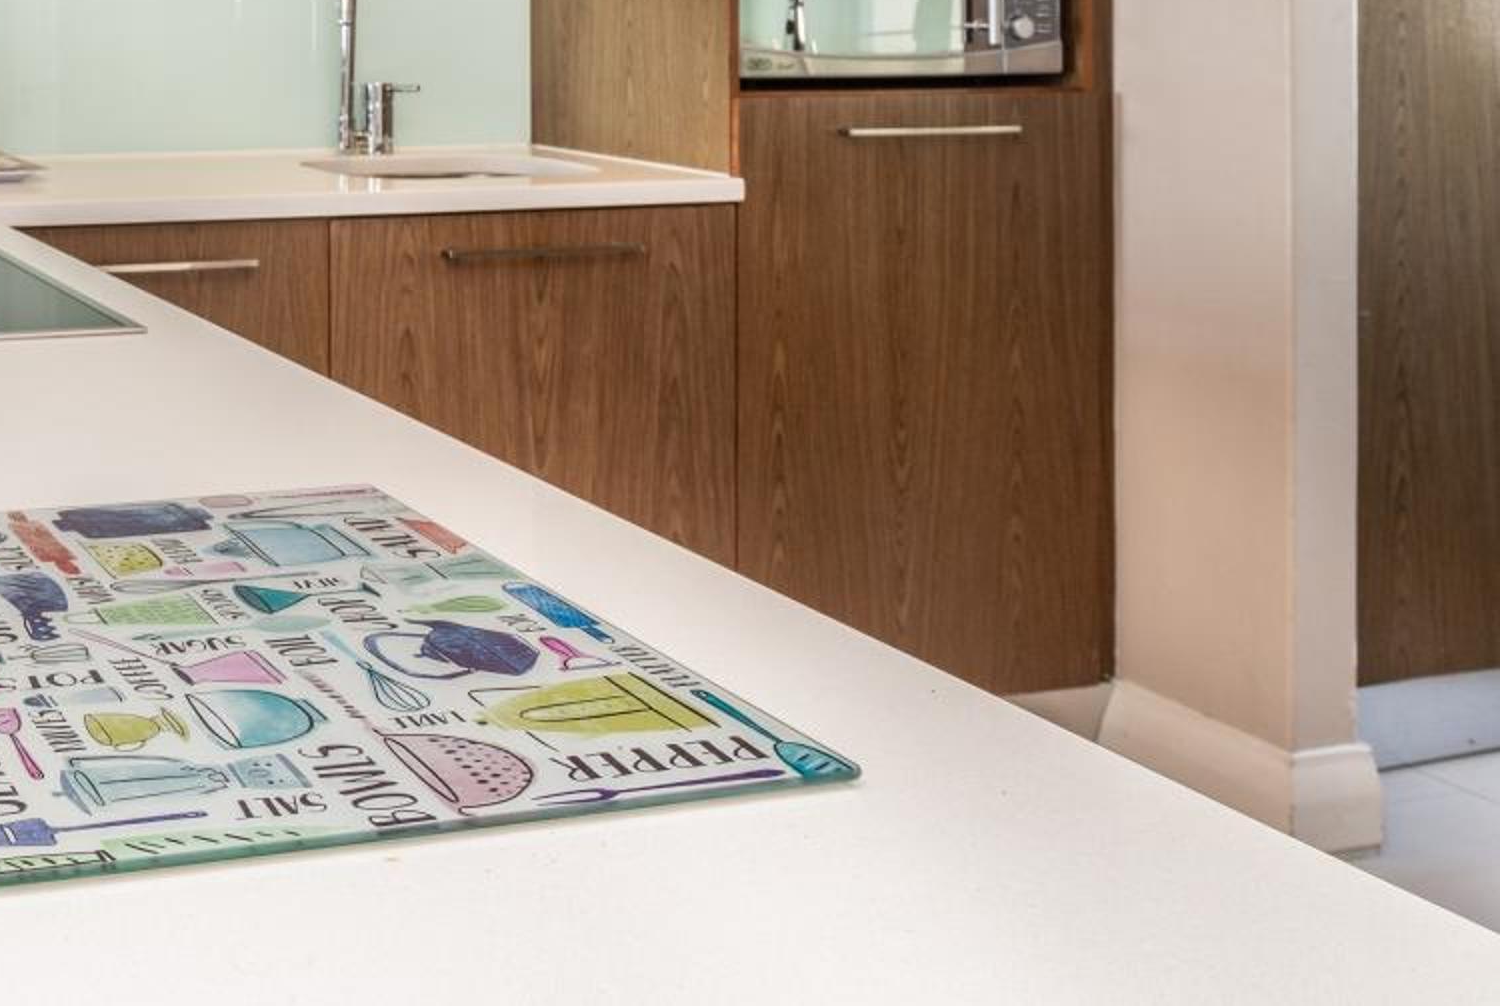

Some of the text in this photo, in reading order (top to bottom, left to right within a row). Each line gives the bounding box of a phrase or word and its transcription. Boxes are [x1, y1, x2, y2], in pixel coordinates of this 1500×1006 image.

[154, 636, 247, 656] SUGAR
[108, 657, 175, 701] COFFEE
[548, 735, 774, 782] PEPPER
[236, 793, 328, 821] SALT
[299, 743, 438, 830] BOWLS
